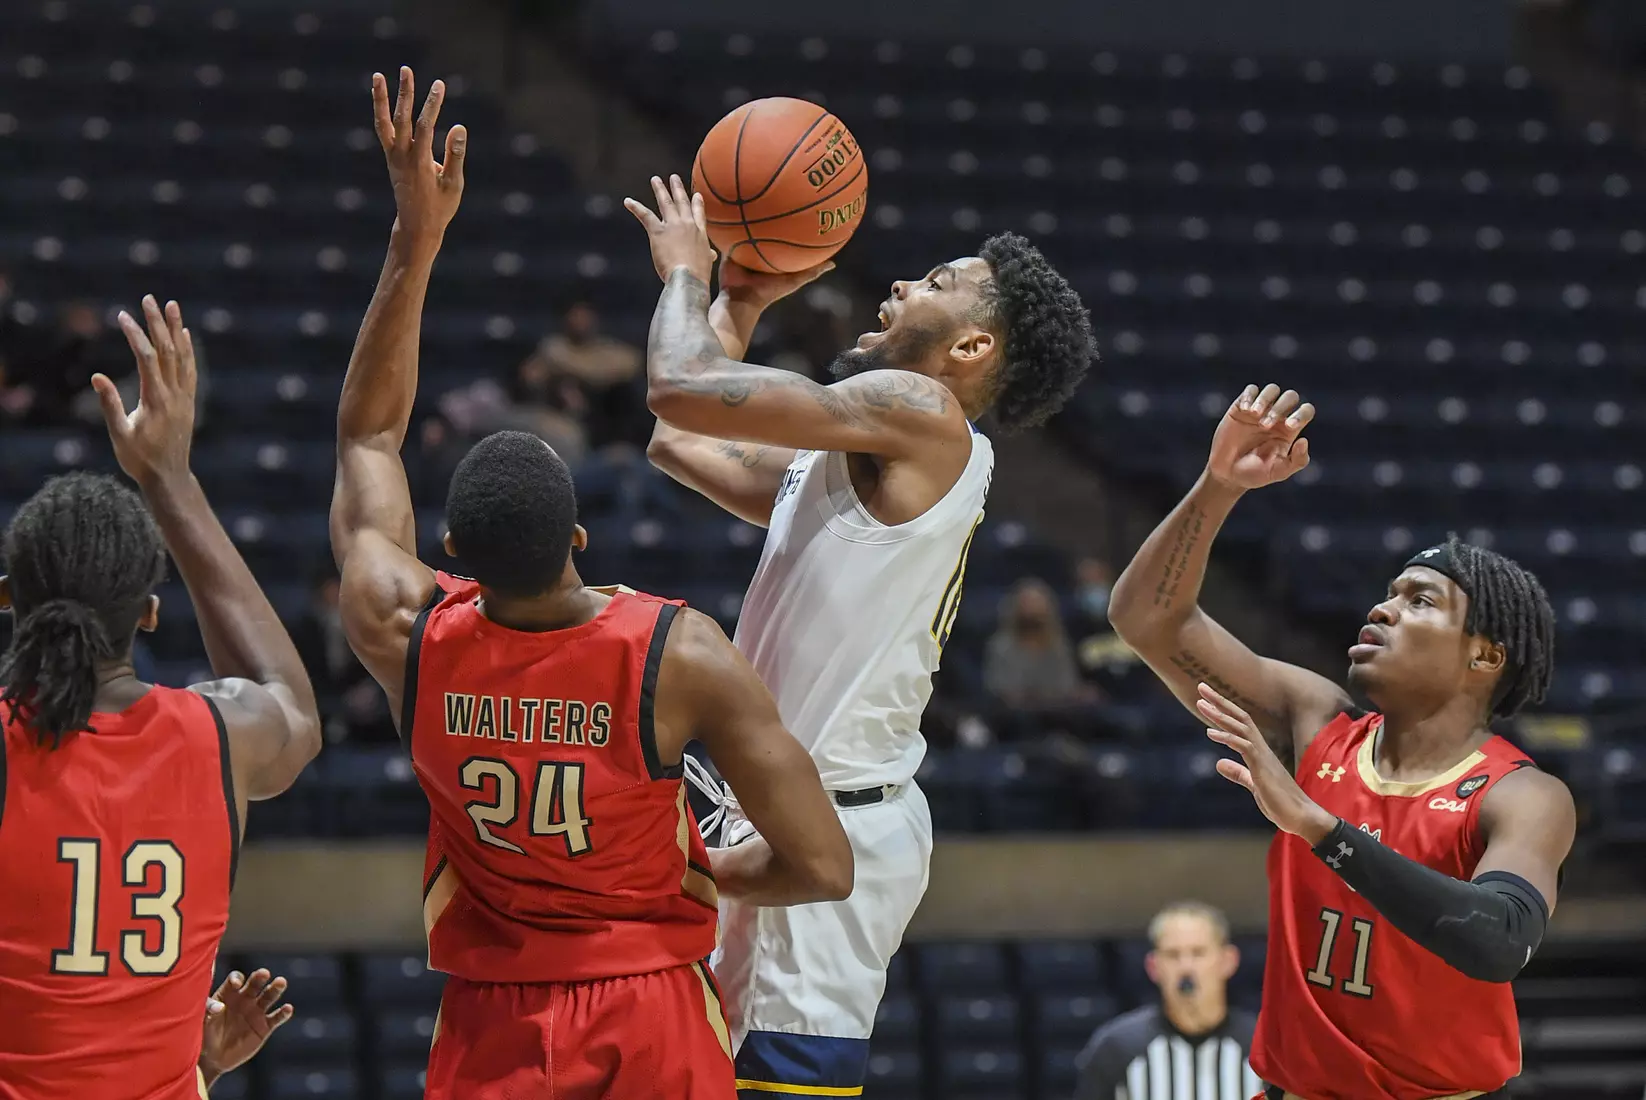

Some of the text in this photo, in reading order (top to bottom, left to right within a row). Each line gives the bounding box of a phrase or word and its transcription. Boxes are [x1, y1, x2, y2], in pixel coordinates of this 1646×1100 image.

[444, 692, 612, 747] WALTERS
[458, 755, 593, 858] 24
[1428, 797, 1467, 812] CAA
[49, 837, 185, 977] 13
[1306, 907, 1374, 1000] 11
